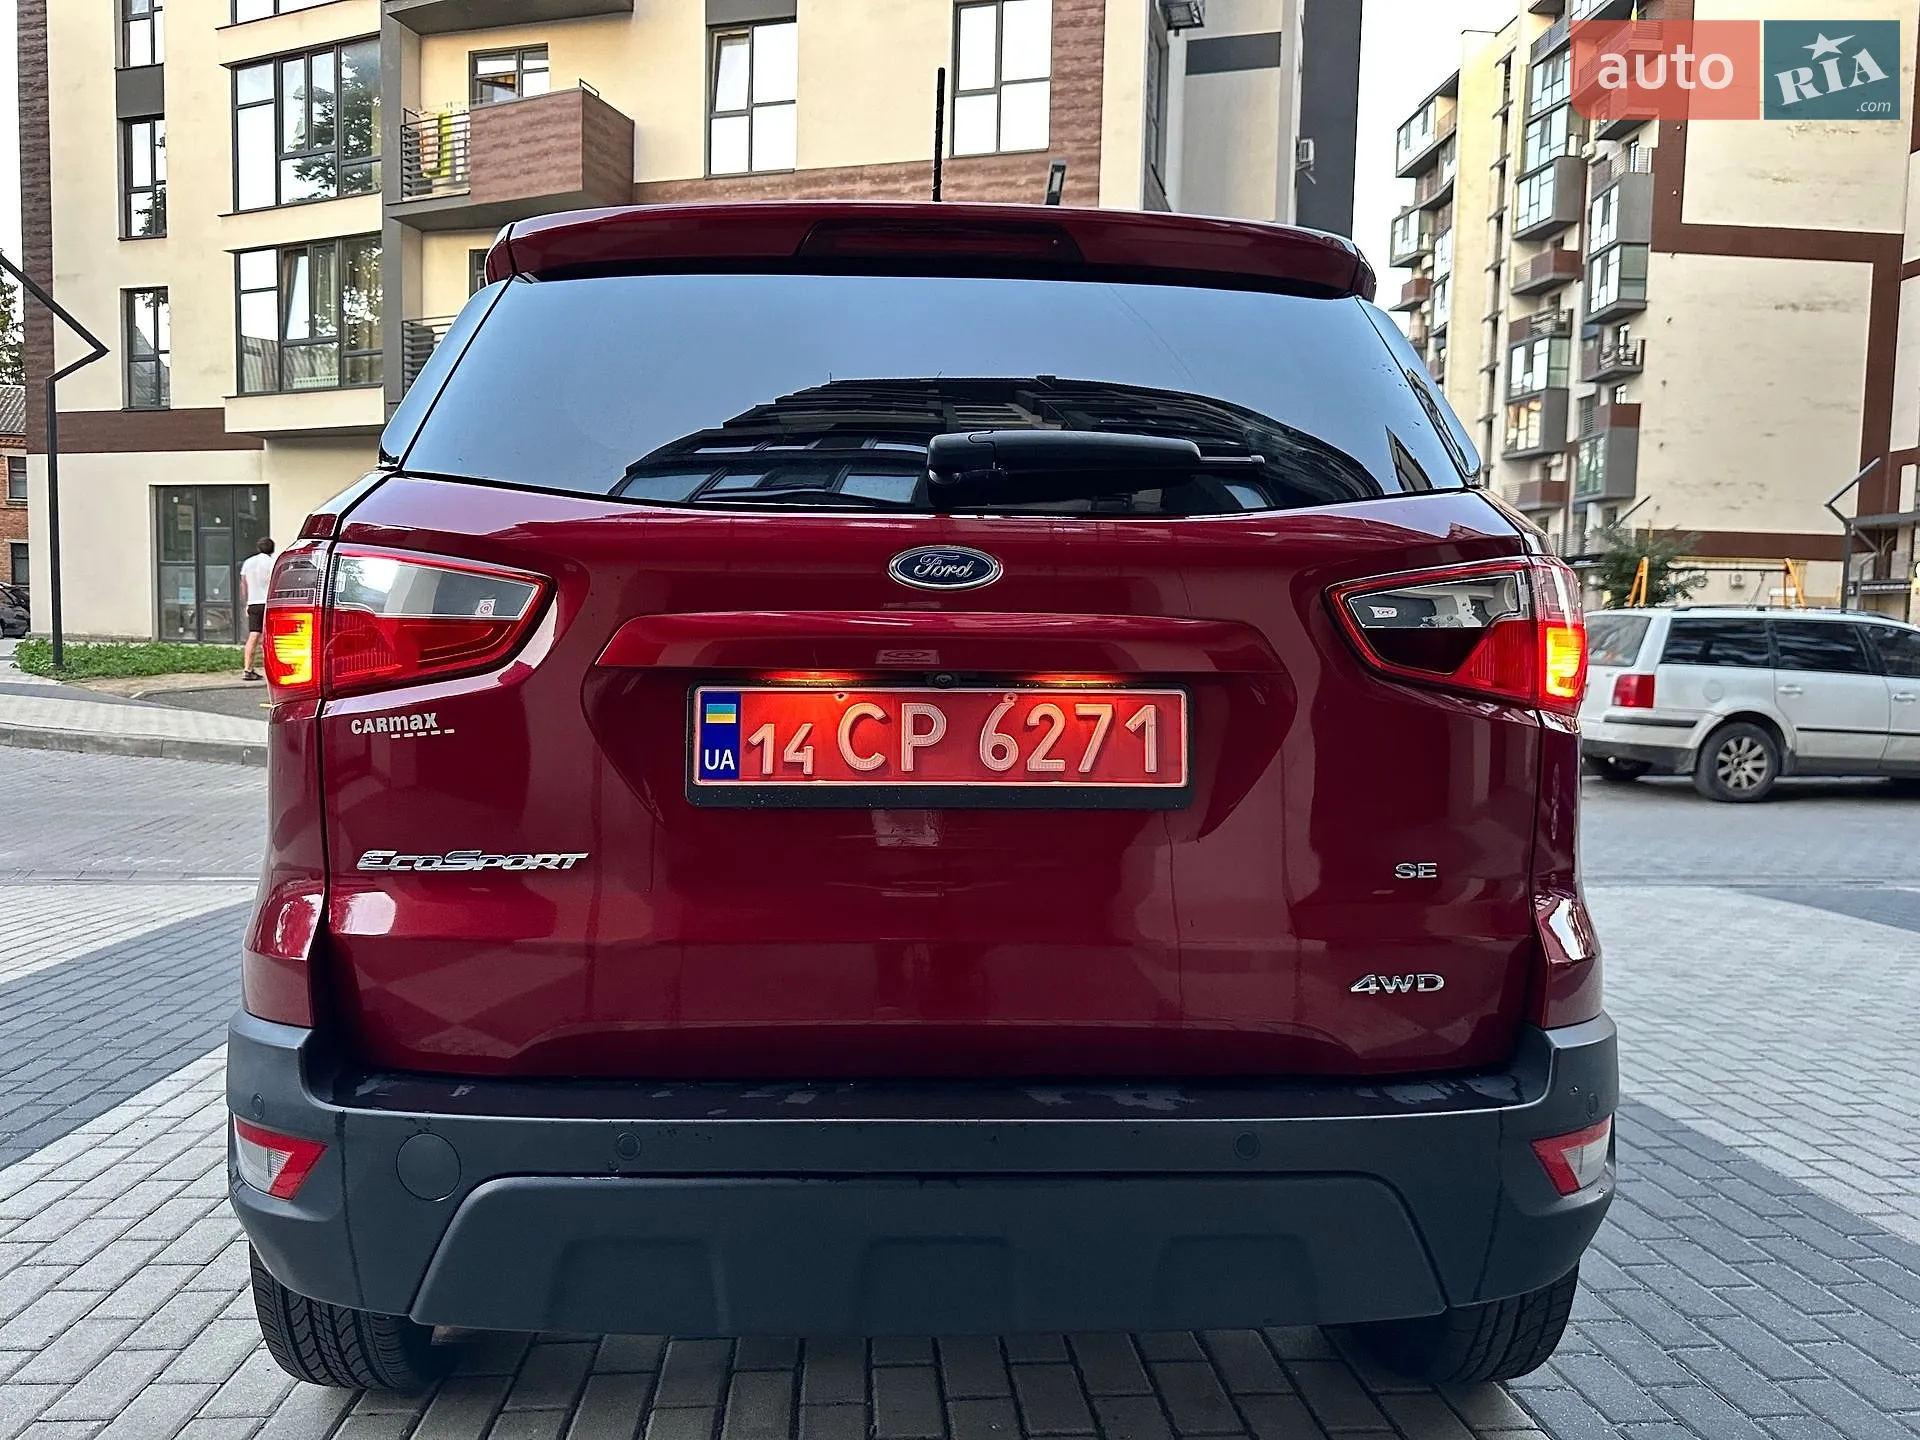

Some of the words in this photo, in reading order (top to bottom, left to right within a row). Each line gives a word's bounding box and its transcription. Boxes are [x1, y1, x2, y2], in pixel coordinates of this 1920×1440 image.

[914, 554, 974, 577] Ford
[747, 723, 814, 774] 14
[837, 703, 947, 772] CP
[979, 703, 1157, 773] 6271
[704, 749, 735, 771] UA
[1395, 863, 1437, 878] SE
[1351, 974, 1444, 994] 4WD
